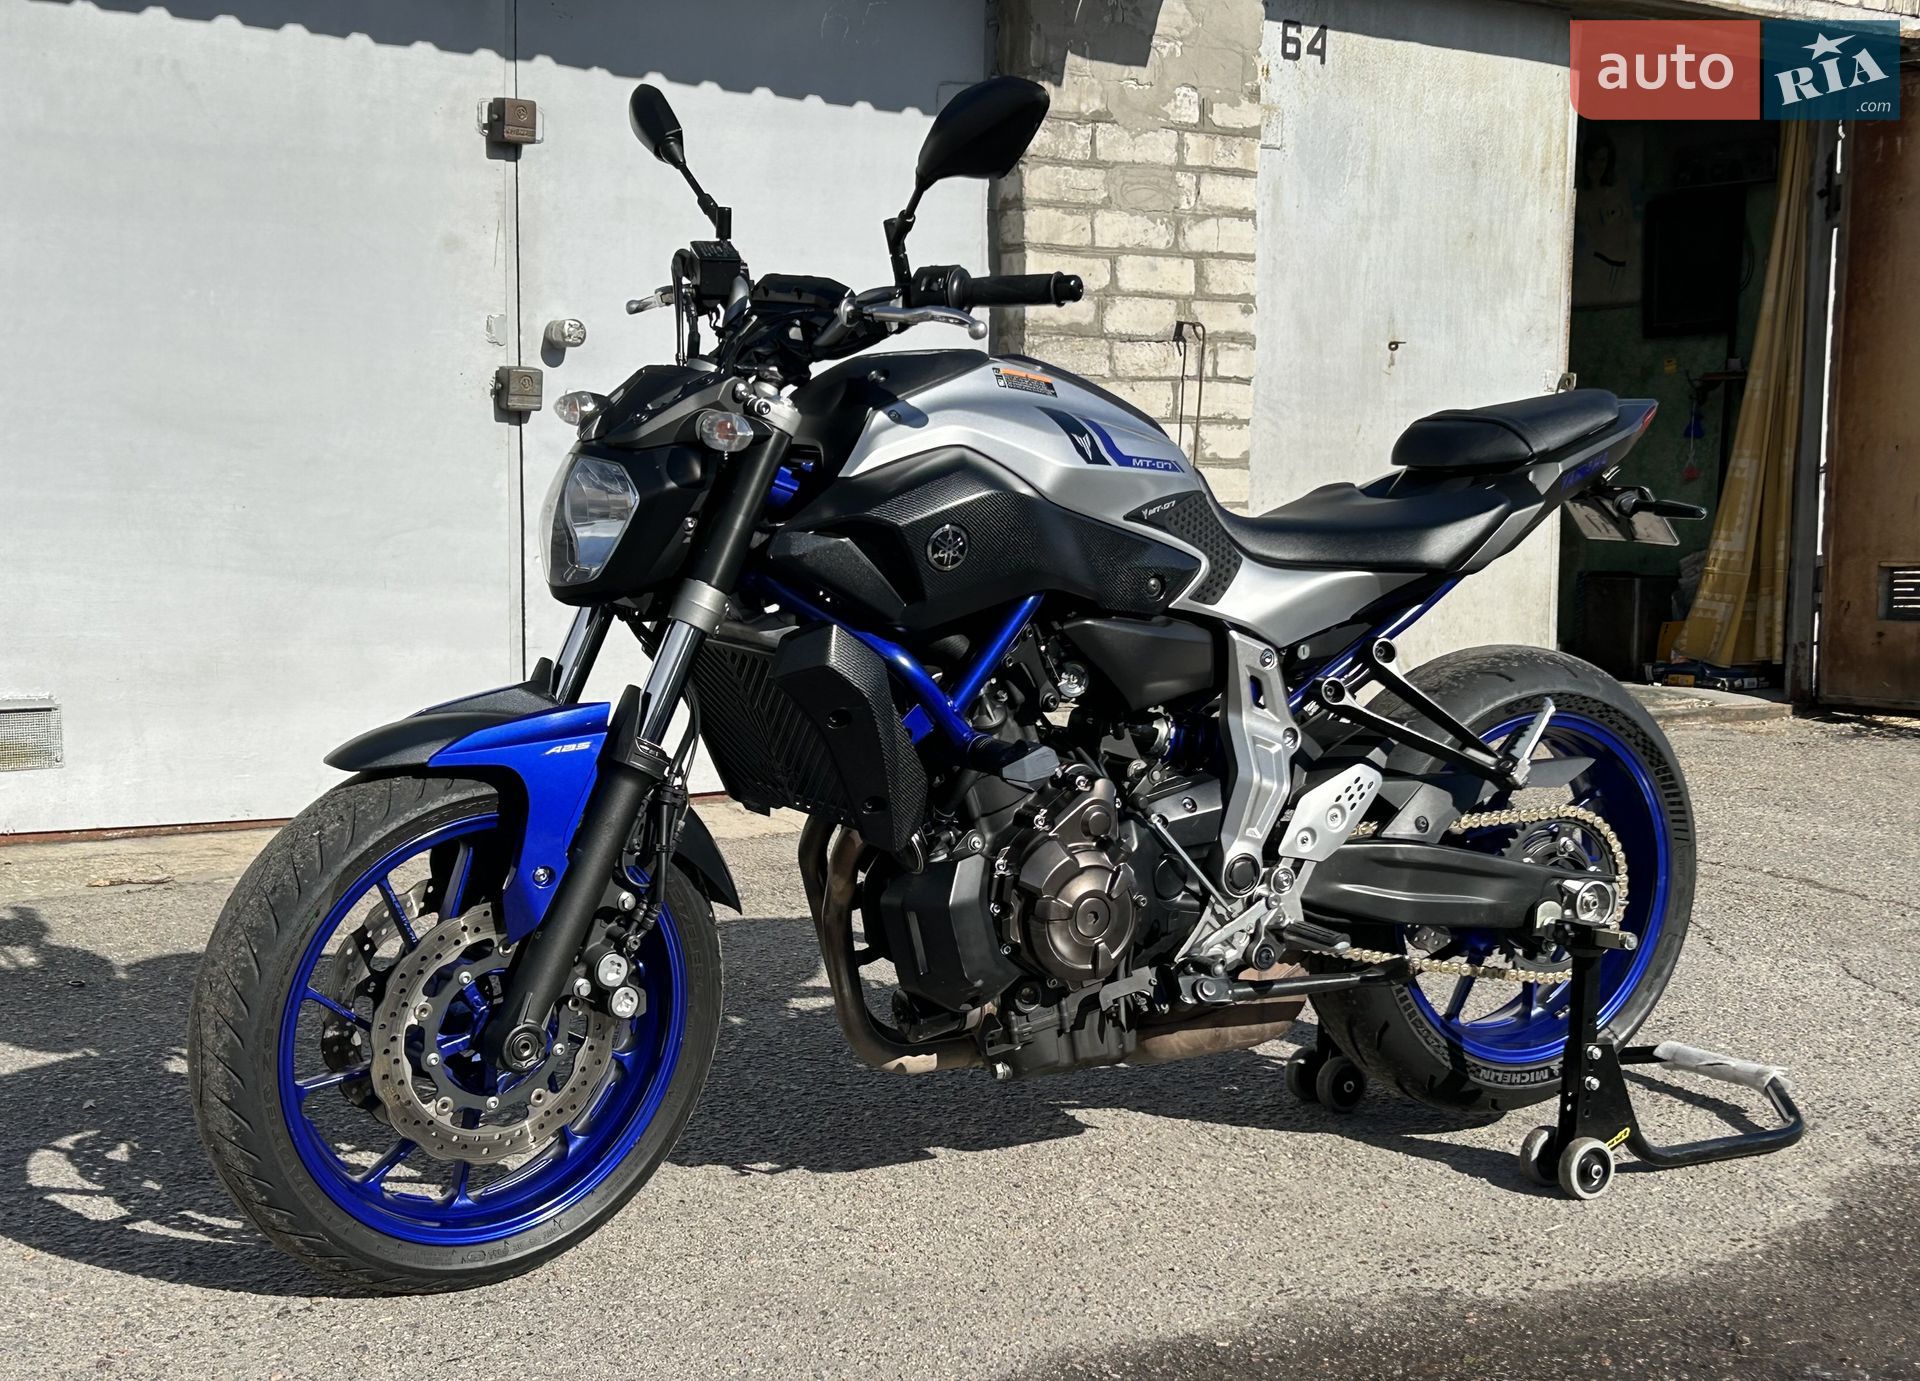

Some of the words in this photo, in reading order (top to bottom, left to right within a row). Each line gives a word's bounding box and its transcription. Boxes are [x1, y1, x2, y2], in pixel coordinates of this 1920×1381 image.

[1281, 19, 1327, 65] 64
[544, 741, 592, 755] ABS
[1480, 1068, 1549, 1084] MICHELIN
